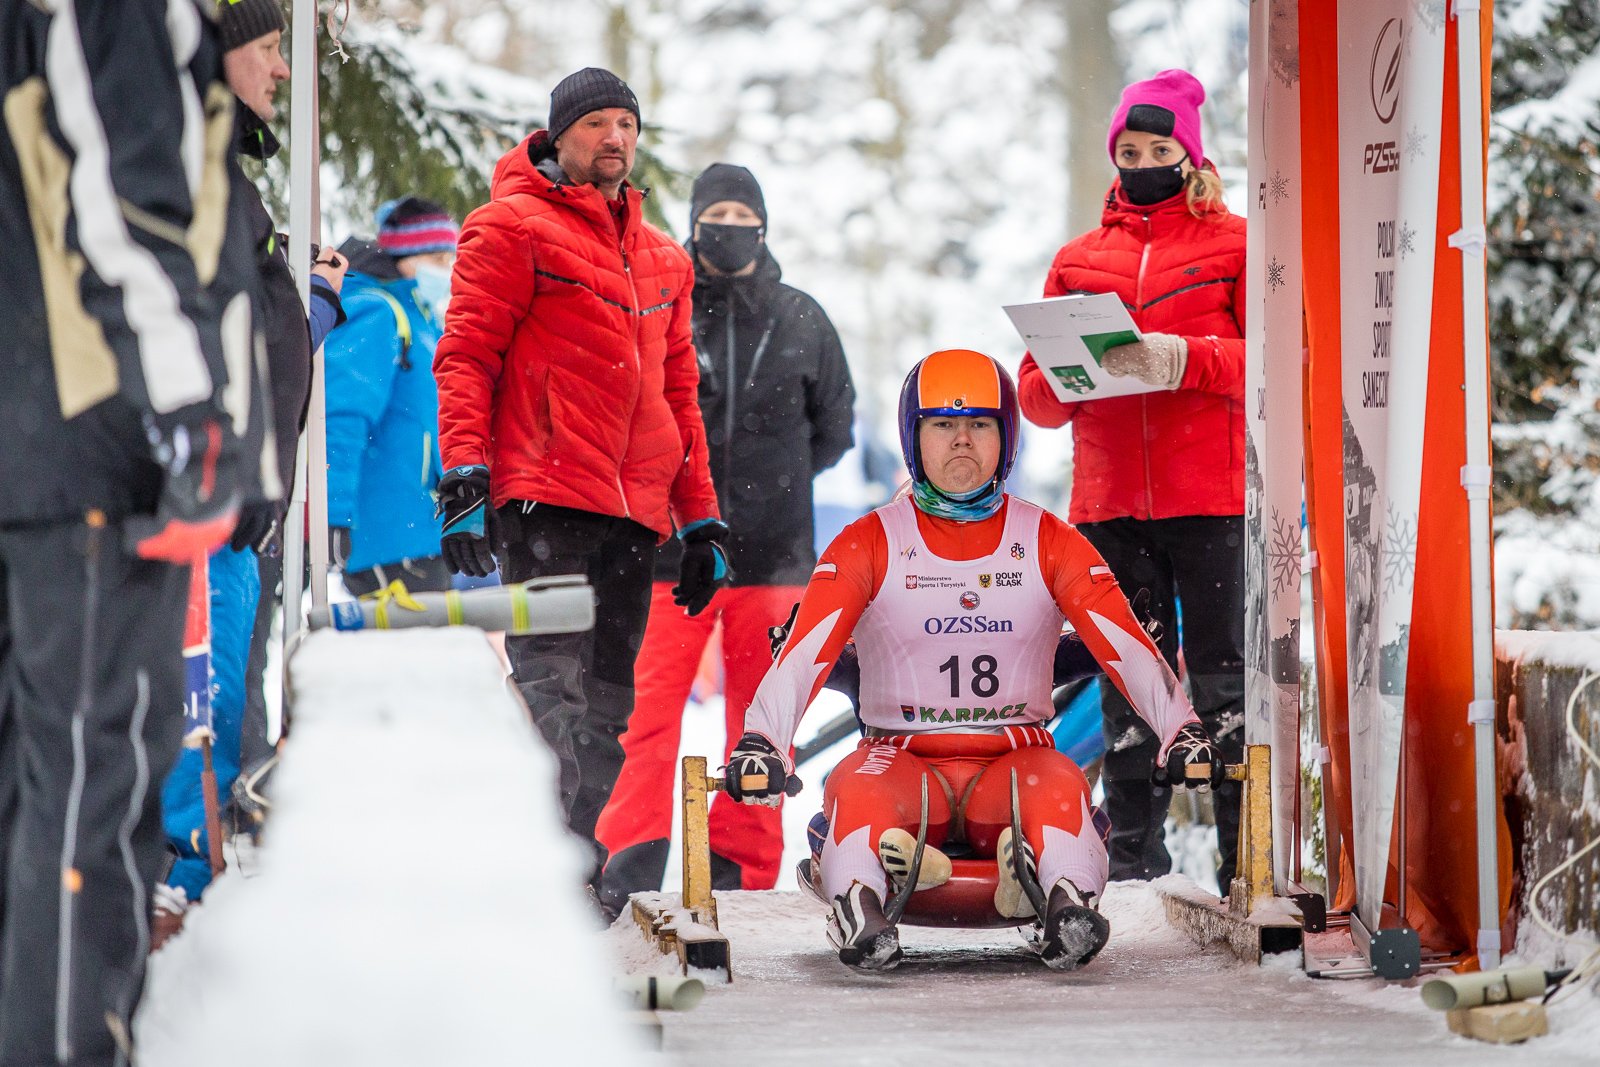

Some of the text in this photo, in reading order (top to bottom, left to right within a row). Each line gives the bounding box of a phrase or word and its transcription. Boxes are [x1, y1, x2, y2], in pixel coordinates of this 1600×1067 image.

[995, 571, 1023, 580] DOLNY
[924, 615, 1013, 635] OZSSan
[939, 655, 1000, 699] 18
[919, 703, 1028, 723] KARPACZ
